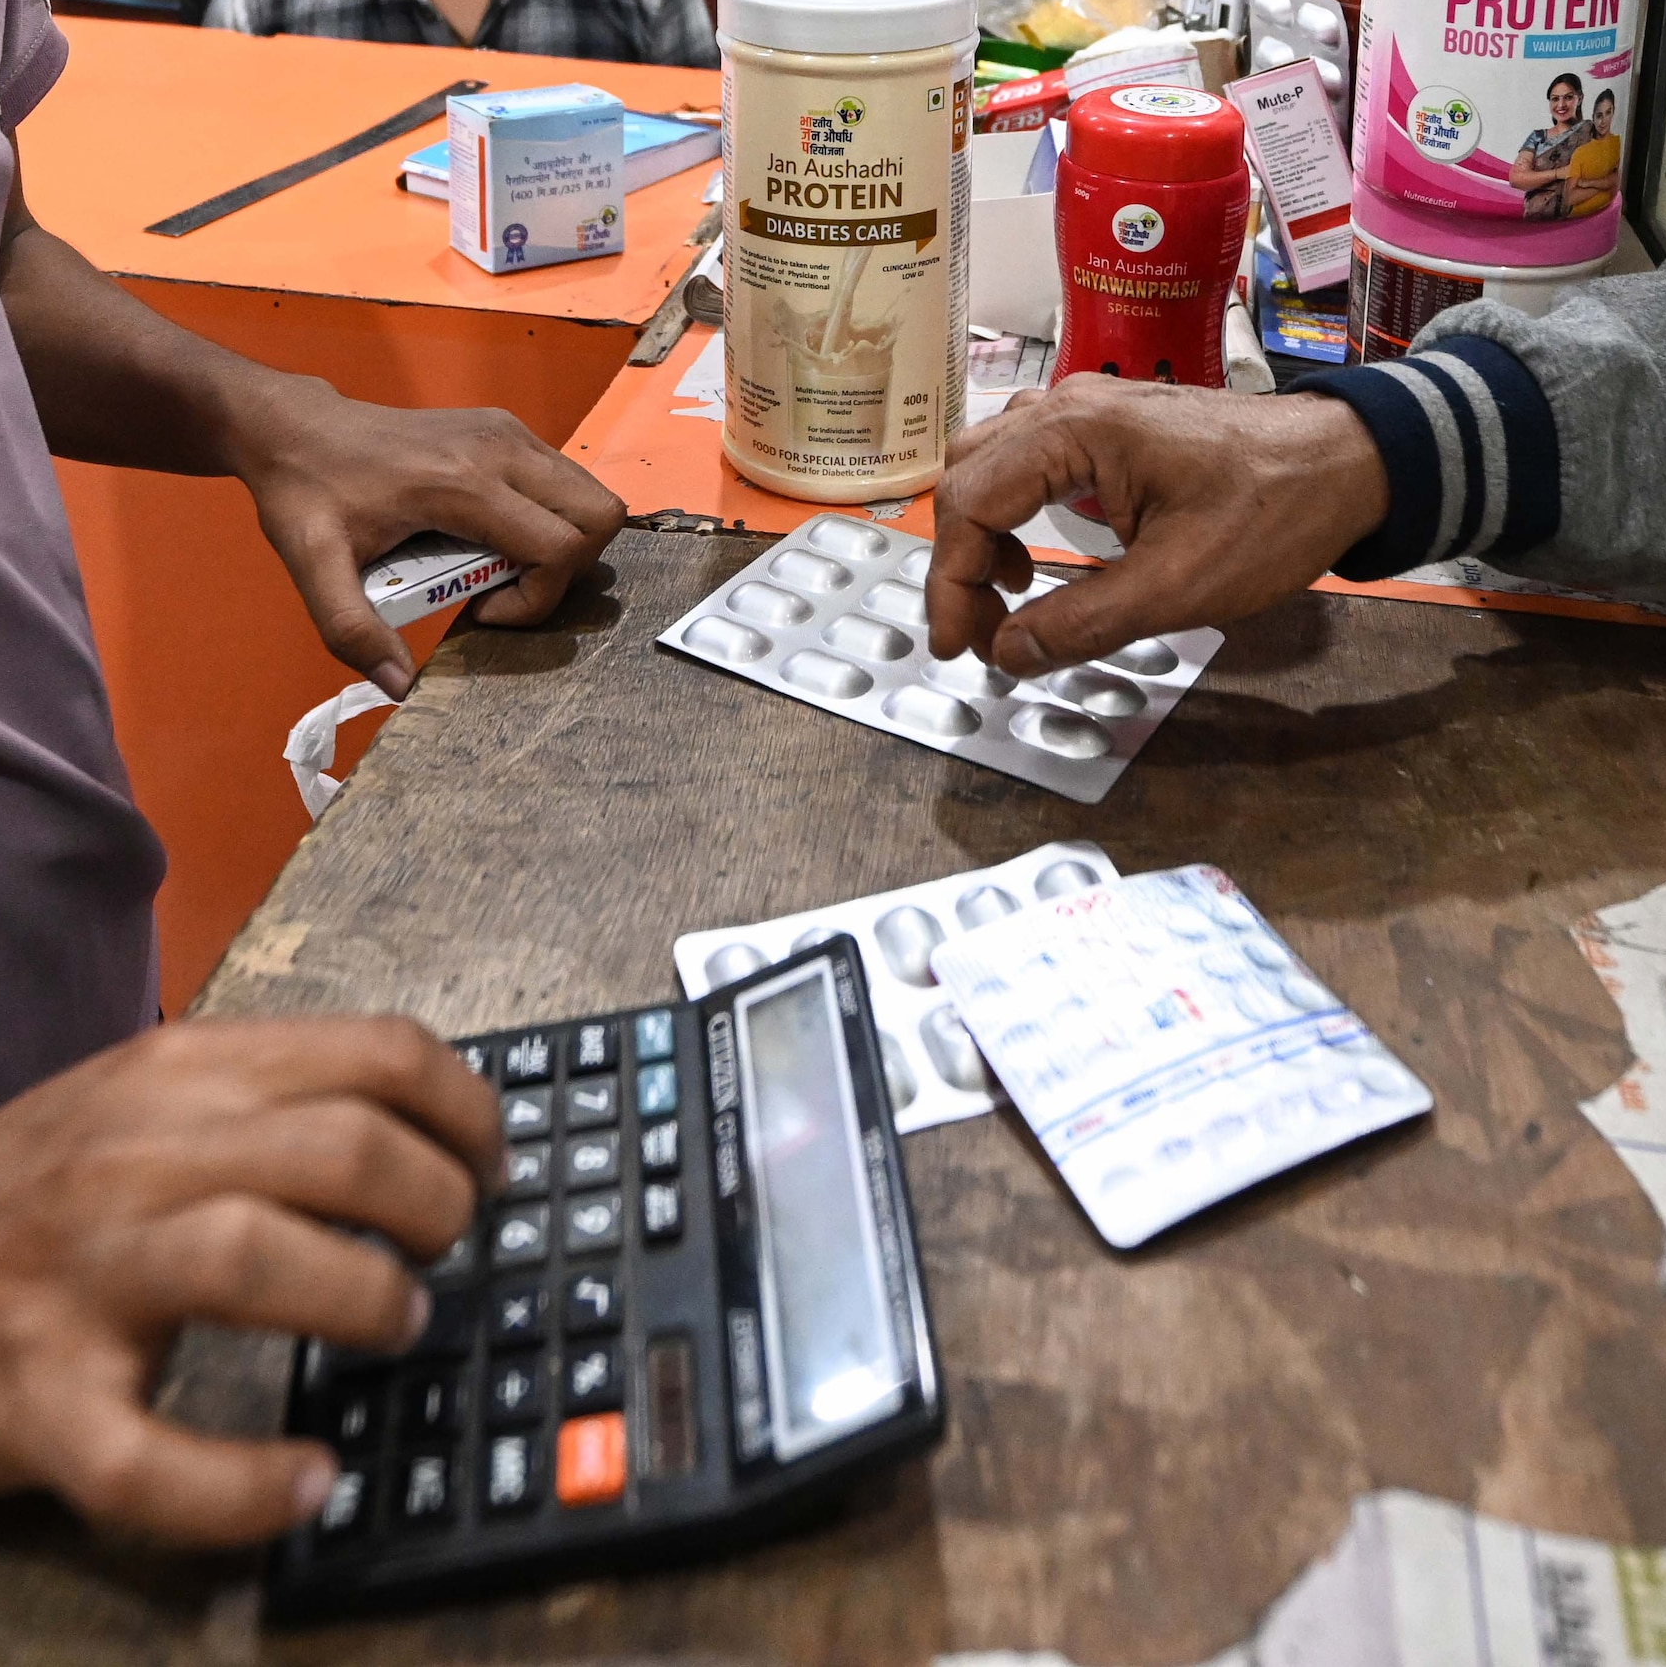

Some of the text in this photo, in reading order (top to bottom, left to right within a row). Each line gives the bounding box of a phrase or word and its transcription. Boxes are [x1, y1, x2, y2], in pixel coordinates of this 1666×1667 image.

[1444, 27, 1612, 59] BOOST VANILLA FLAVOUR
[991, 81, 1044, 104] RED
[1257, 86, 1304, 111] Mute-P
[1272, 102, 1296, 115] SYRUP
[1415, 111, 1442, 124] भारतीय
[800, 115, 833, 129] भारतीय
[990, 107, 1045, 133] RED
[800, 127, 853, 143] जन औषधि
[1415, 121, 1459, 140] जन औषधि
[801, 141, 845, 157] परियोजना
[1416, 132, 1451, 150] परियोजना
[767, 153, 904, 180] Jan Aushadhi
[766, 177, 903, 210] PROTEIN
[1074, 187, 1090, 200] 500g
[1404, 189, 1458, 209] Nutraceutical
[766, 217, 903, 241] DIABETES CARE
[748, 249, 767, 263] product
[773, 256, 780, 264] to
[780, 257, 789, 266] be
[790, 260, 808, 269] taken
[809, 262, 830, 272] under
[882, 257, 941, 274] CLINICALLY PROVEN
[1087, 252, 1188, 277] Jan Aushadhi
[758, 263, 775, 273] advice
[778, 268, 785, 276] of
[788, 270, 818, 282] Physician
[902, 272, 914, 281] LOW
[794, 280, 831, 291] nutritional
[1073, 265, 1200, 300] CHYAWANPRASH
[1107, 302, 1162, 318] SPECIAL
[795, 385, 885, 397] Multivitamin, Multimineral
[796, 395, 812, 404] with
[813, 397, 838, 406] Taurine
[840, 398, 851, 406] and
[827, 408, 852, 416] Powder
[904, 413, 928, 426] Vanilla
[807, 425, 871, 435] For Individuals with
[902, 425, 928, 438] Flavour
[808, 435, 871, 445] Diabetic Conditions
[753, 439, 918, 466] FOOD FOR SPECIAL DIETARY USE
[787, 463, 875, 477] Food for Diabetic Care
[574, 1089, 609, 1112] 7
[508, 1100, 542, 1125] 4
[574, 1146, 610, 1171] 8
[573, 1205, 611, 1235] 9
[500, 1220, 539, 1250] 6
